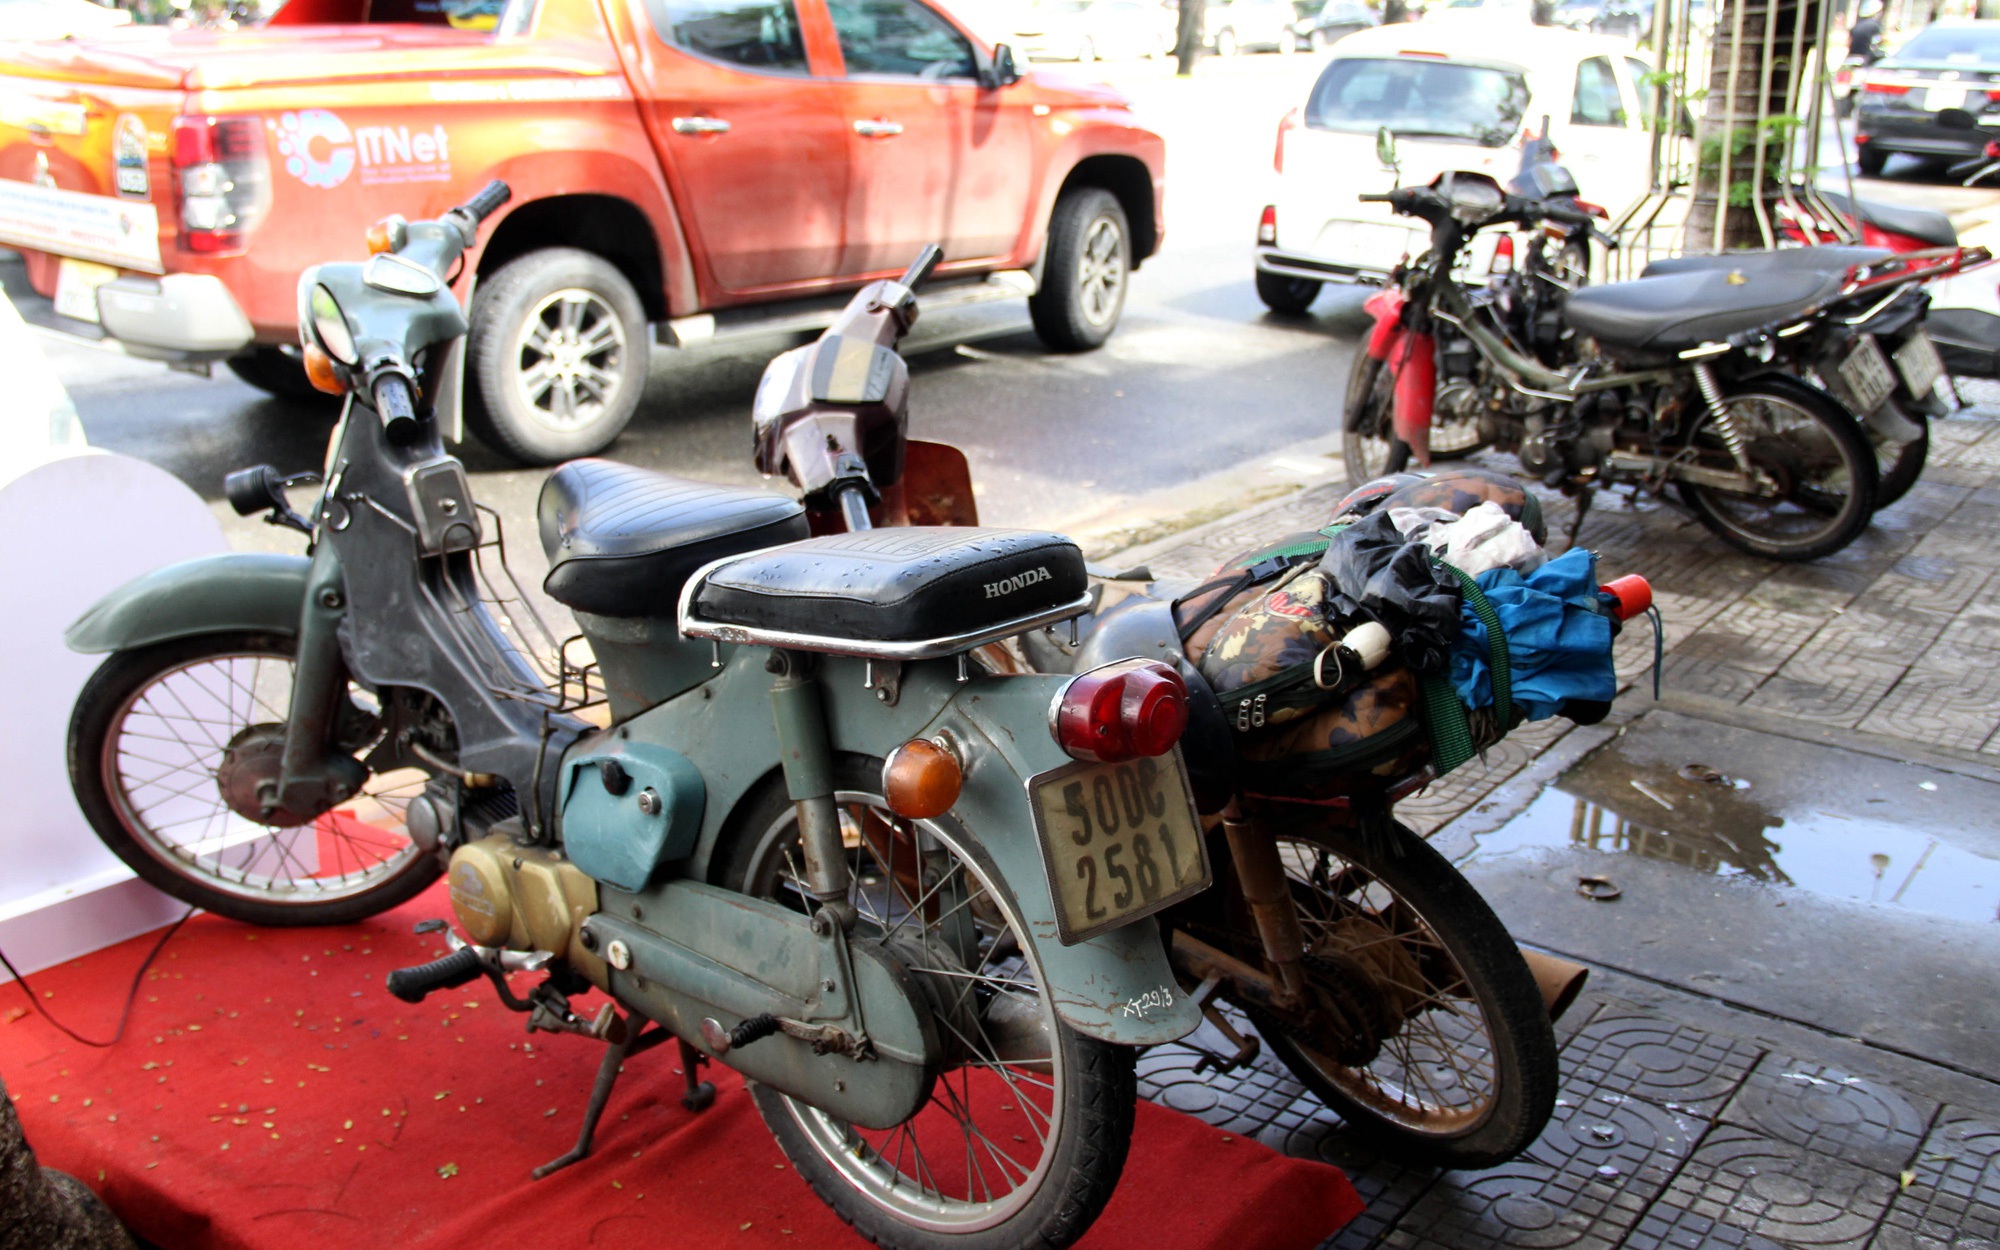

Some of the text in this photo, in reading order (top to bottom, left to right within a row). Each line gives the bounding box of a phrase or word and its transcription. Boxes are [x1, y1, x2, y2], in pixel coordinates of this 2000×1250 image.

[355, 124, 449, 168] ITNet
[983, 566, 1053, 599] HONDA
[1076, 823, 1184, 921] 2581
